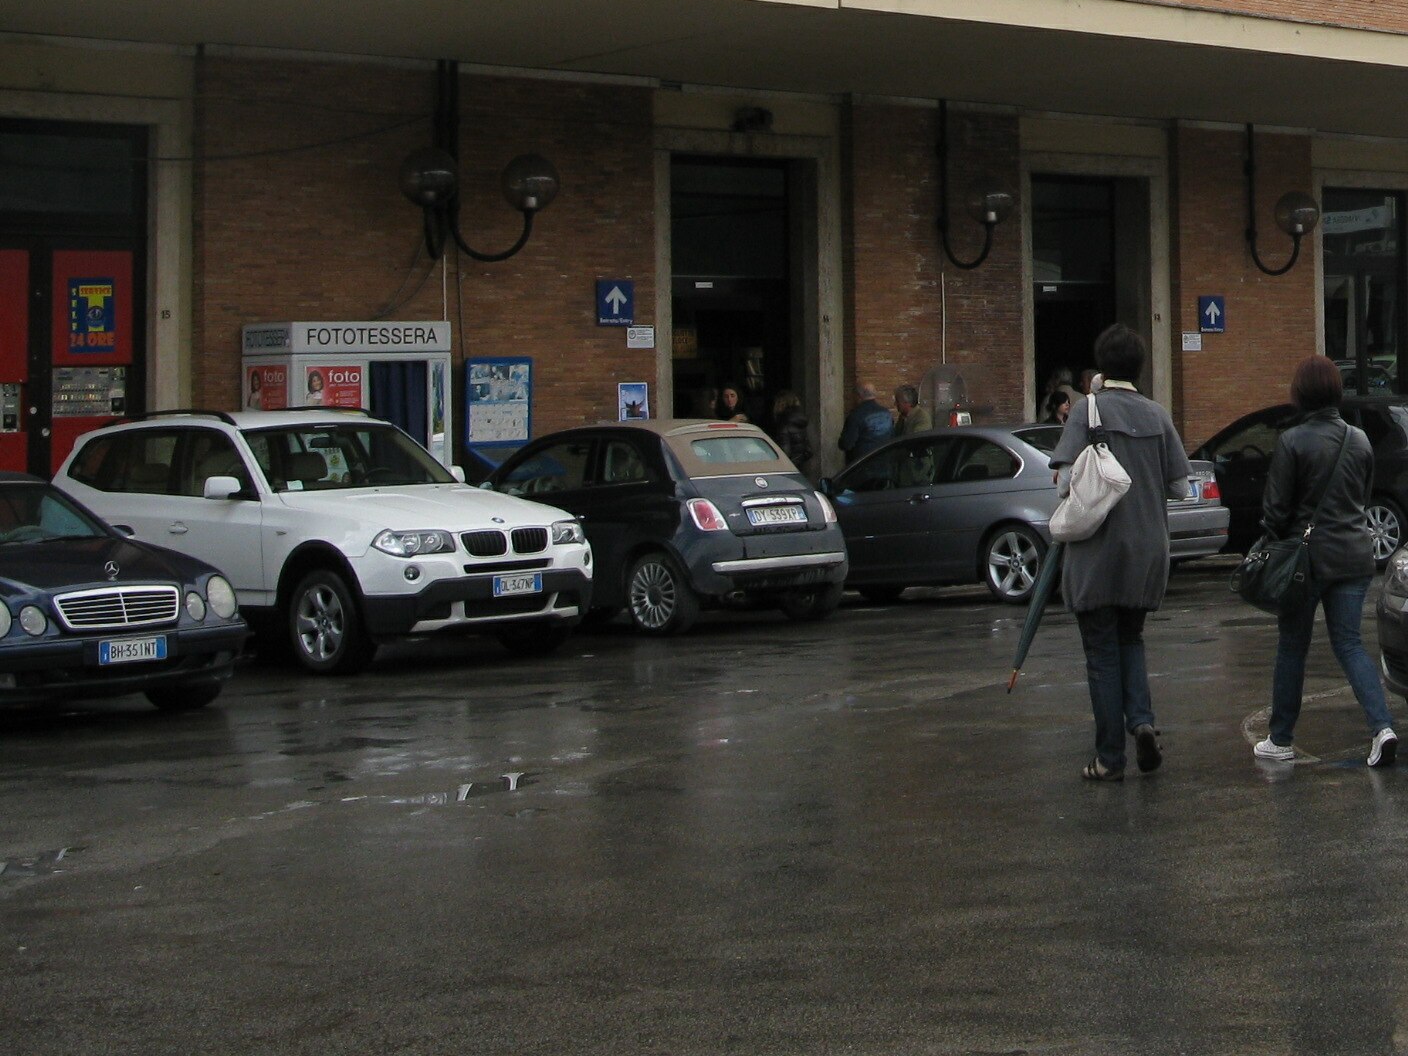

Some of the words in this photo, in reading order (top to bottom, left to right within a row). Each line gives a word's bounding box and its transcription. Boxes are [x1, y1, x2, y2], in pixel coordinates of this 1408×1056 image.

[161, 310, 171, 319] 15
[307, 328, 438, 345] FOTOTESSERA
[264, 370, 284, 383] foto
[328, 369, 360, 383] foto
